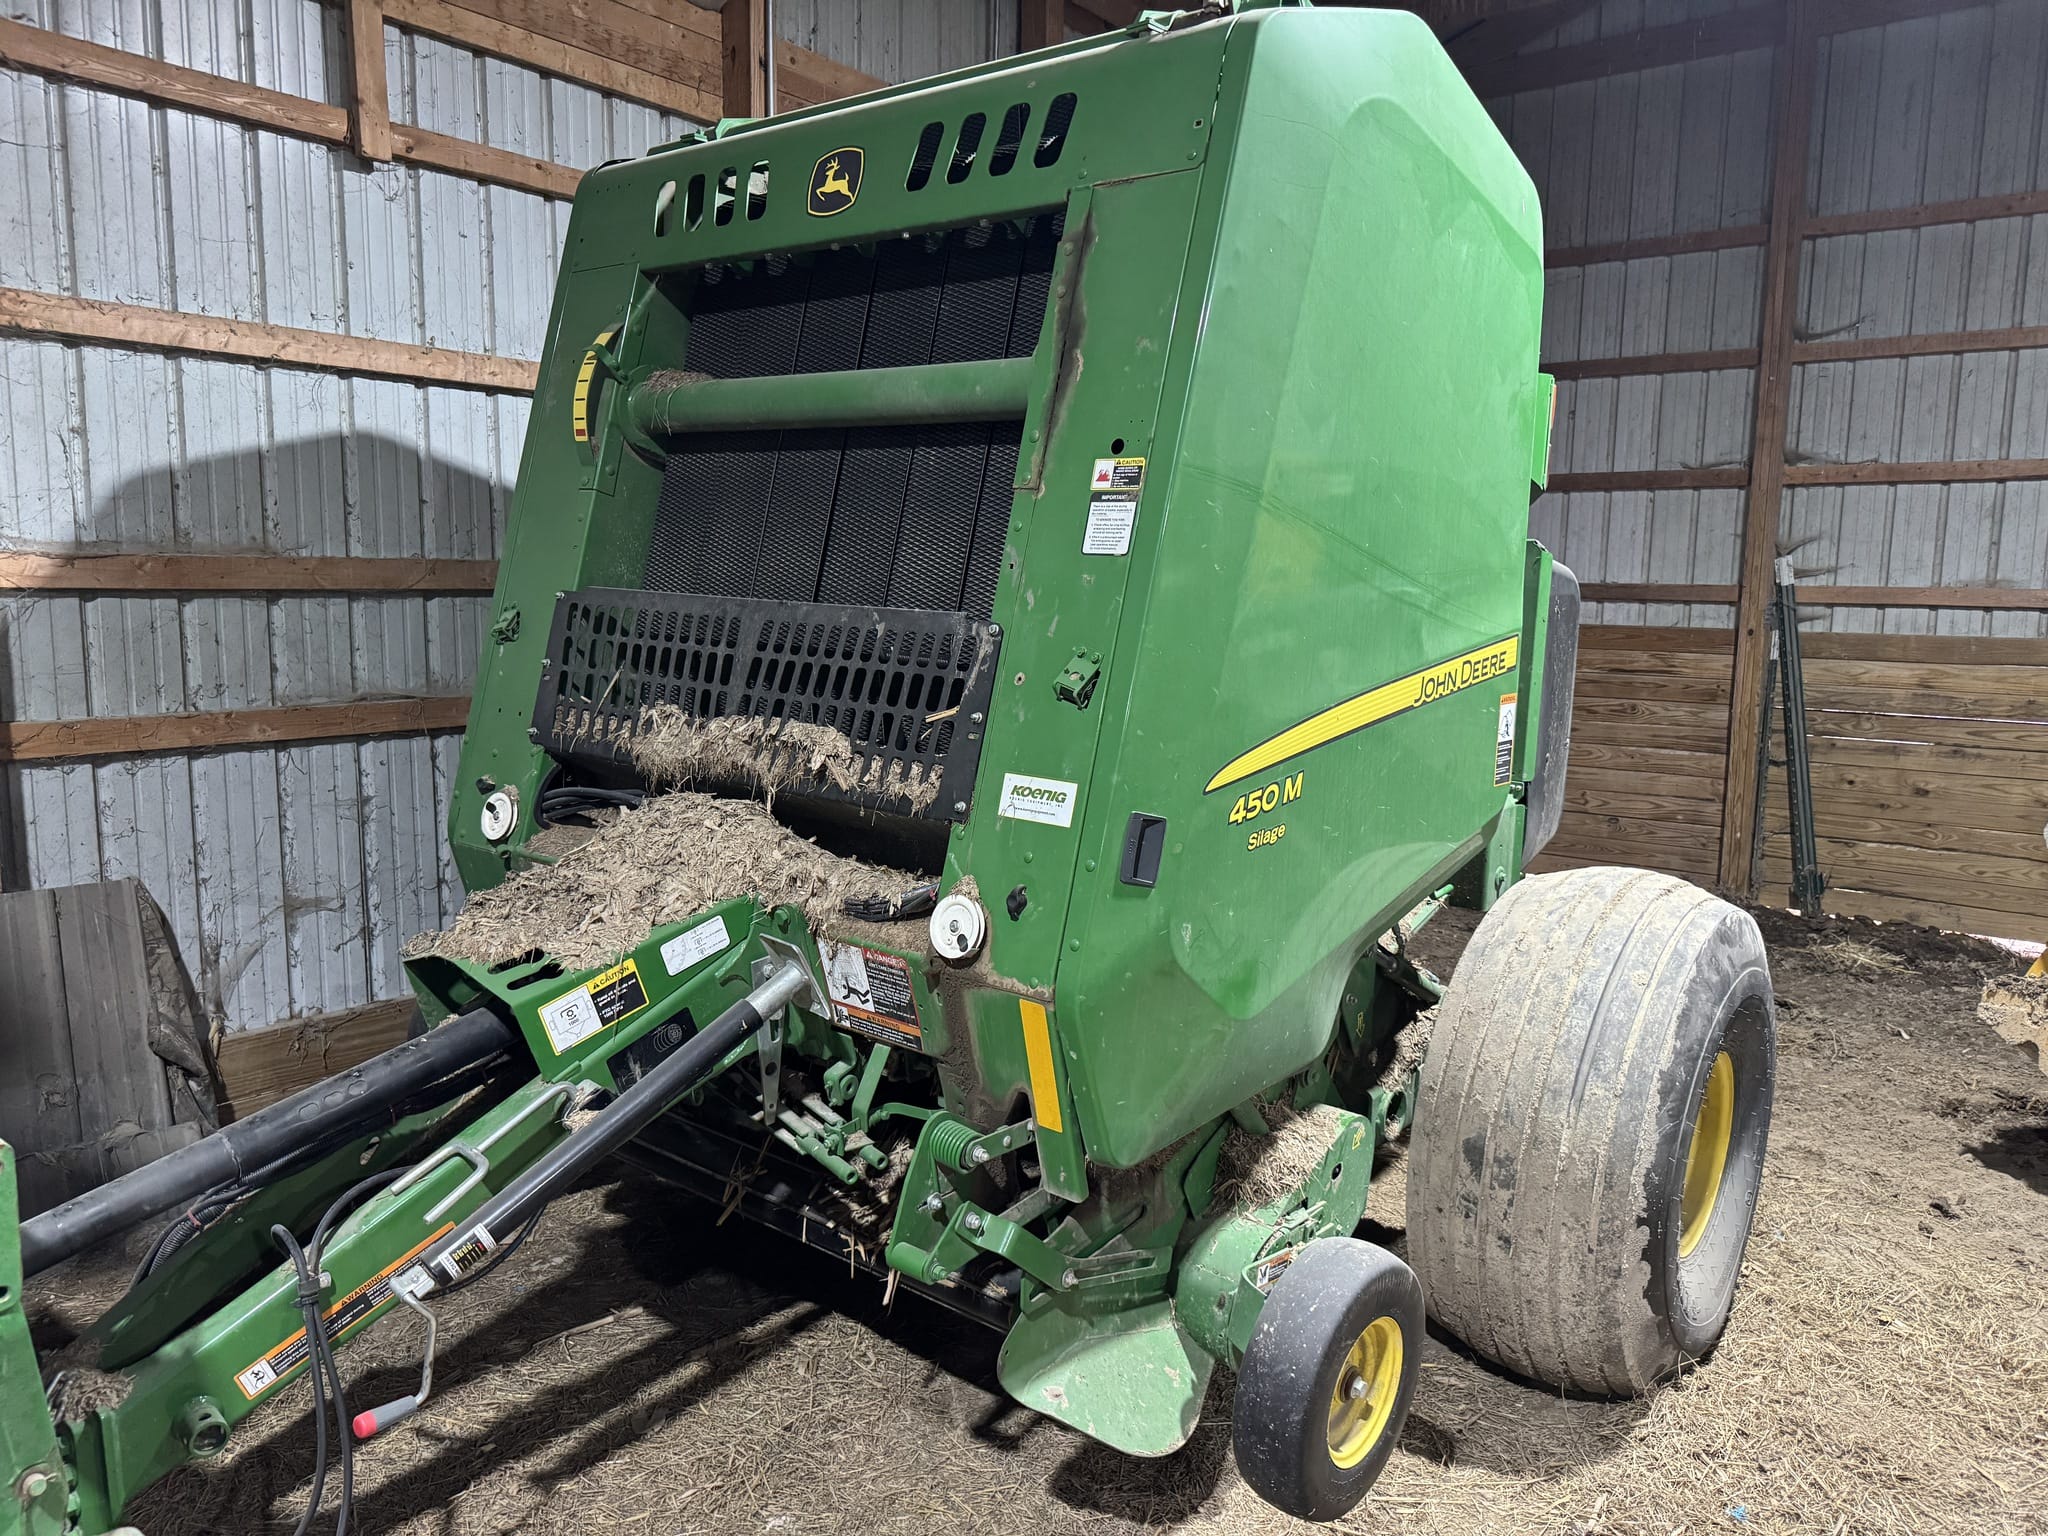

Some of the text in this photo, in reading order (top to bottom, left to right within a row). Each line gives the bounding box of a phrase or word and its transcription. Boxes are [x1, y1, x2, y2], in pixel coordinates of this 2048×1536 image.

[1414, 650, 1507, 704] JOHN DEERE
[1228, 770, 1304, 826] 450 M
[1247, 823, 1286, 851] Silage
[600, 965, 630, 985] CAUTION
[346, 1273, 384, 1303] WARNING
